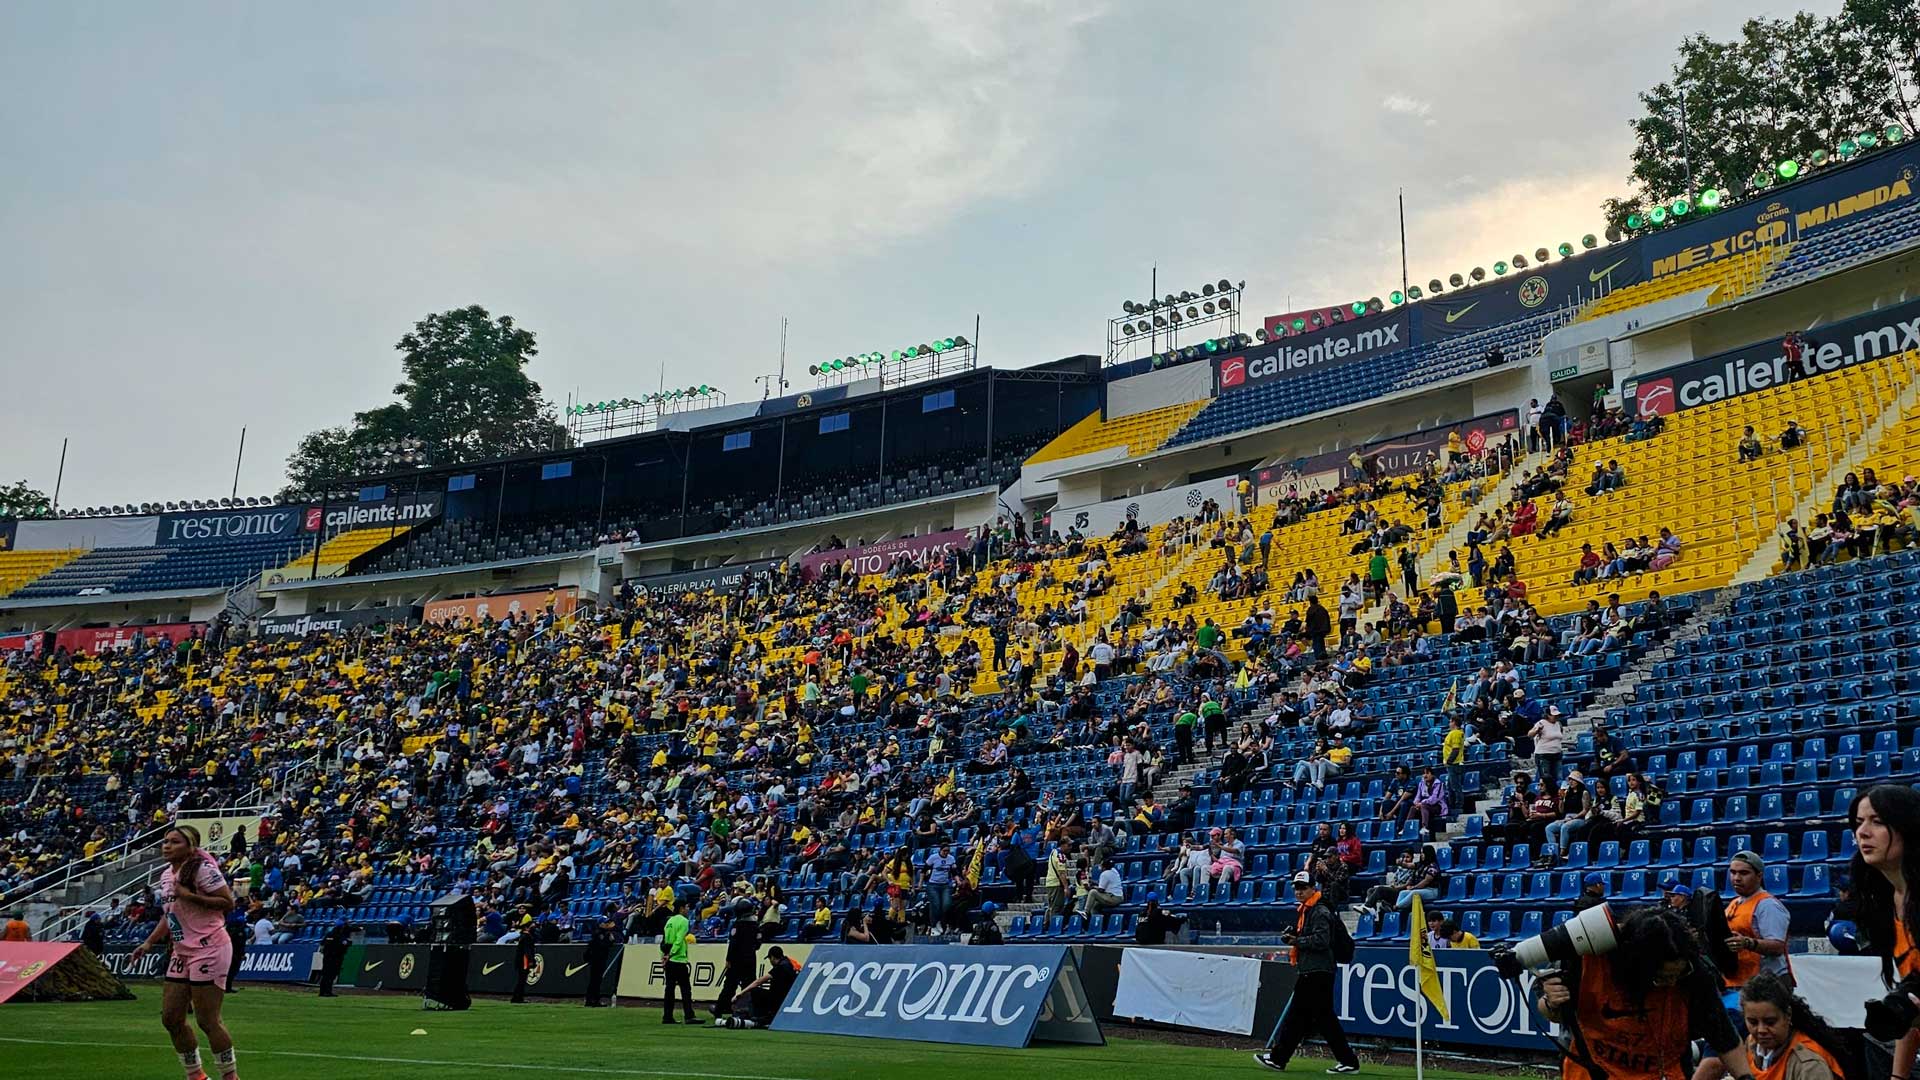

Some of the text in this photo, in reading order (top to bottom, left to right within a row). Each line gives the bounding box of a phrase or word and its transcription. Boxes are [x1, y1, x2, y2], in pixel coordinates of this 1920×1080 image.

[1798, 178, 1912, 231] MANDA
[1756, 206, 1790, 224] Corona
[1249, 323, 1400, 378] caliente.mx
[1679, 316, 1920, 408] caliente.mx
[1551, 367, 1577, 380] SALIDA
[1376, 449, 1431, 474] SUIZ
[325, 503, 434, 526] caliente.mx
[898, 541, 908, 549] DE
[690, 579, 716, 592] PLAZA
[429, 605, 466, 619] GRUPO
